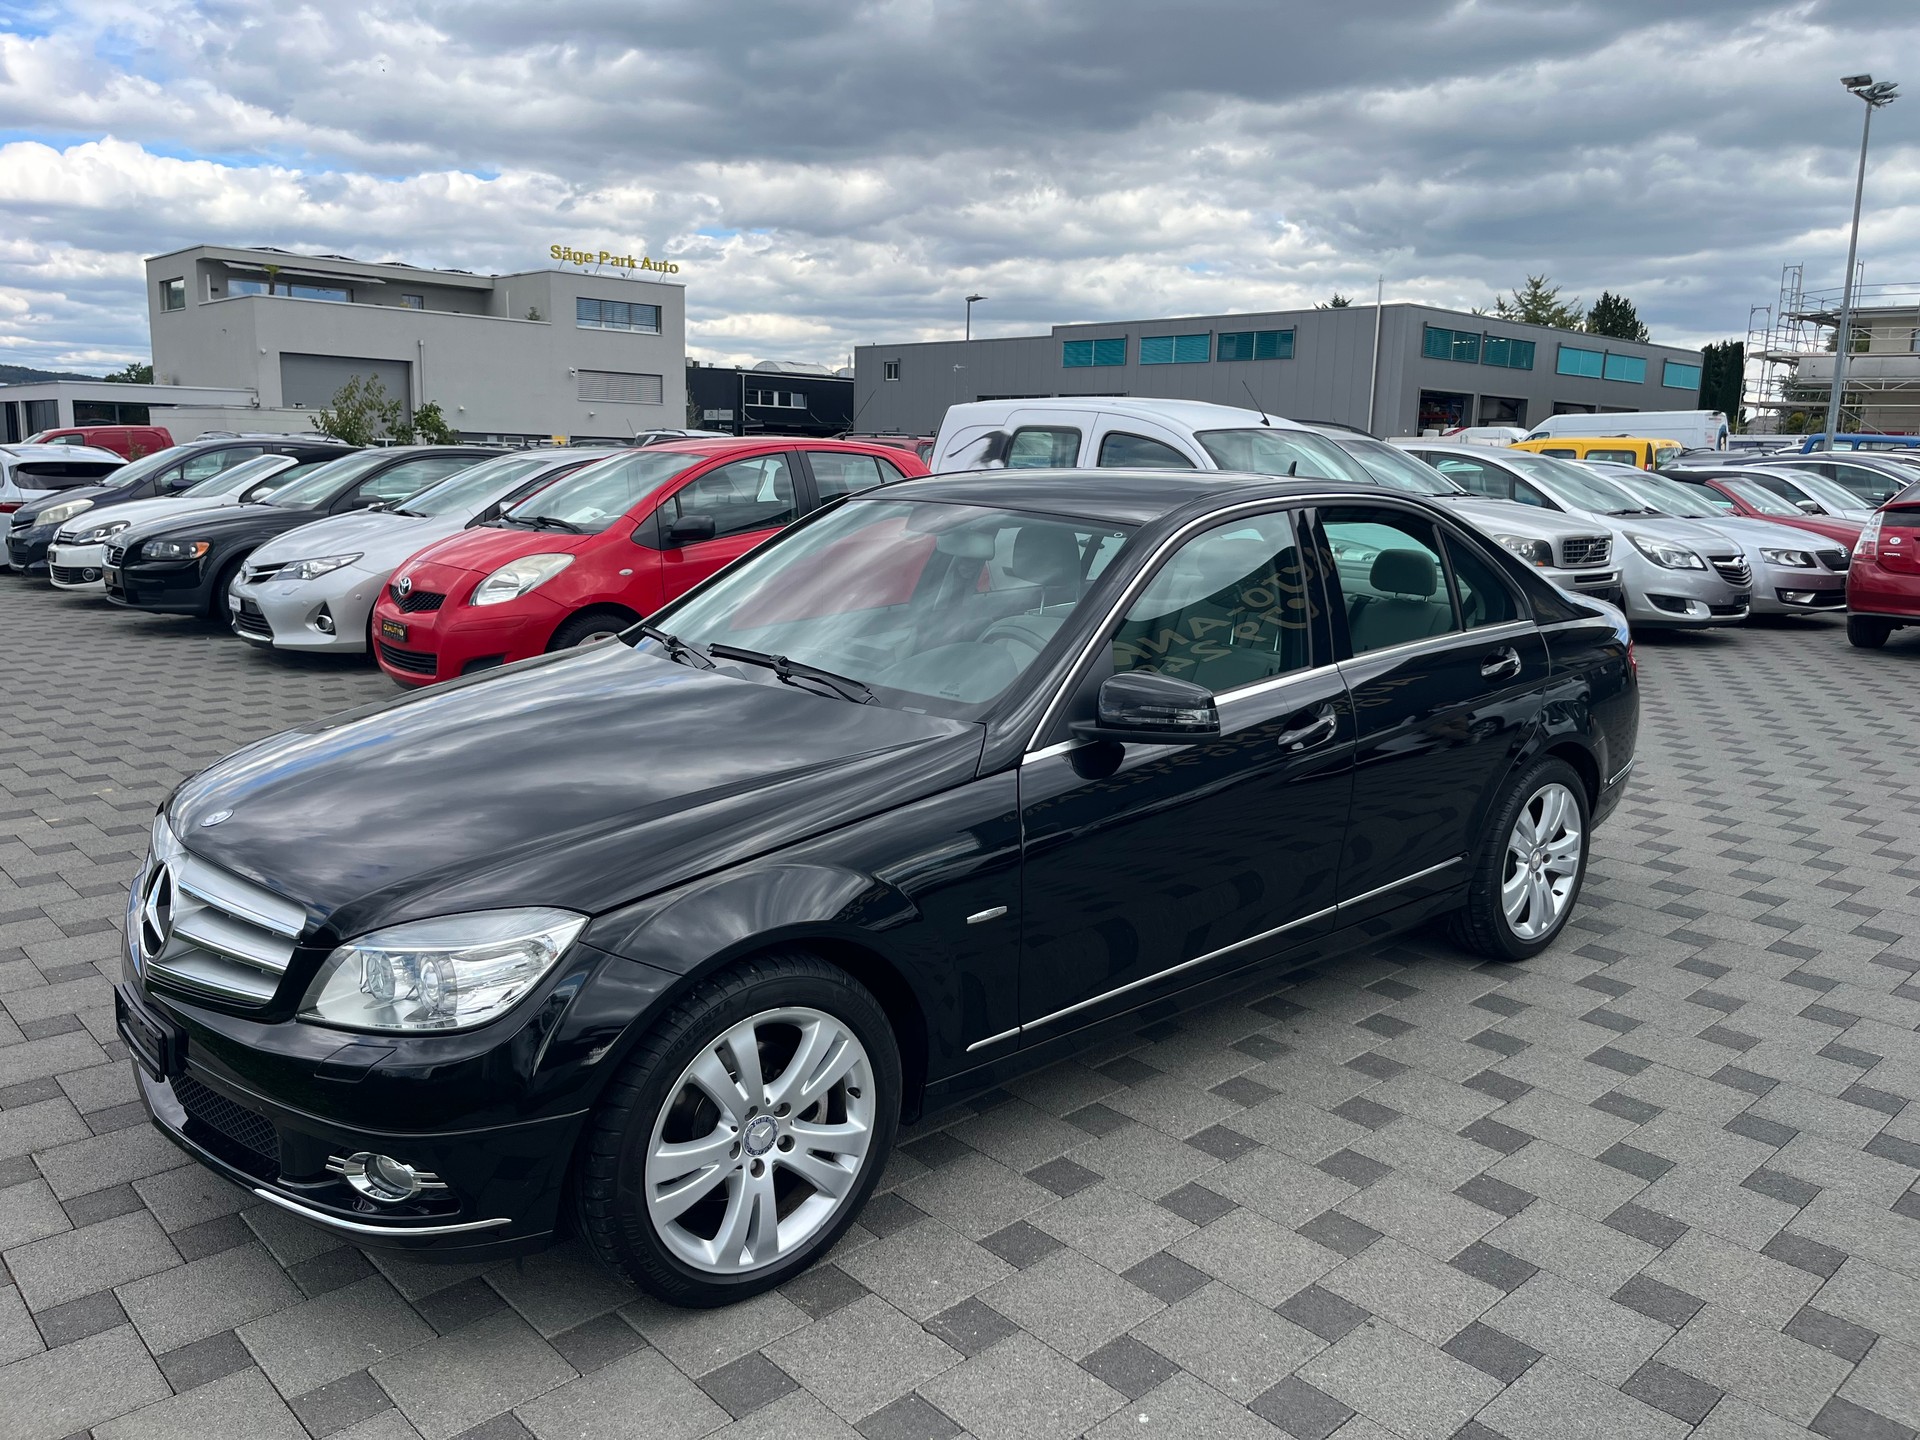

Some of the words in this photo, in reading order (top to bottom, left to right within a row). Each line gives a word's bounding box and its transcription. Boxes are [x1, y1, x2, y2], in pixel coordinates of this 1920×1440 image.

[550, 244, 594, 266] Säge
[599, 251, 637, 268] Park
[641, 256, 680, 274] Auto
